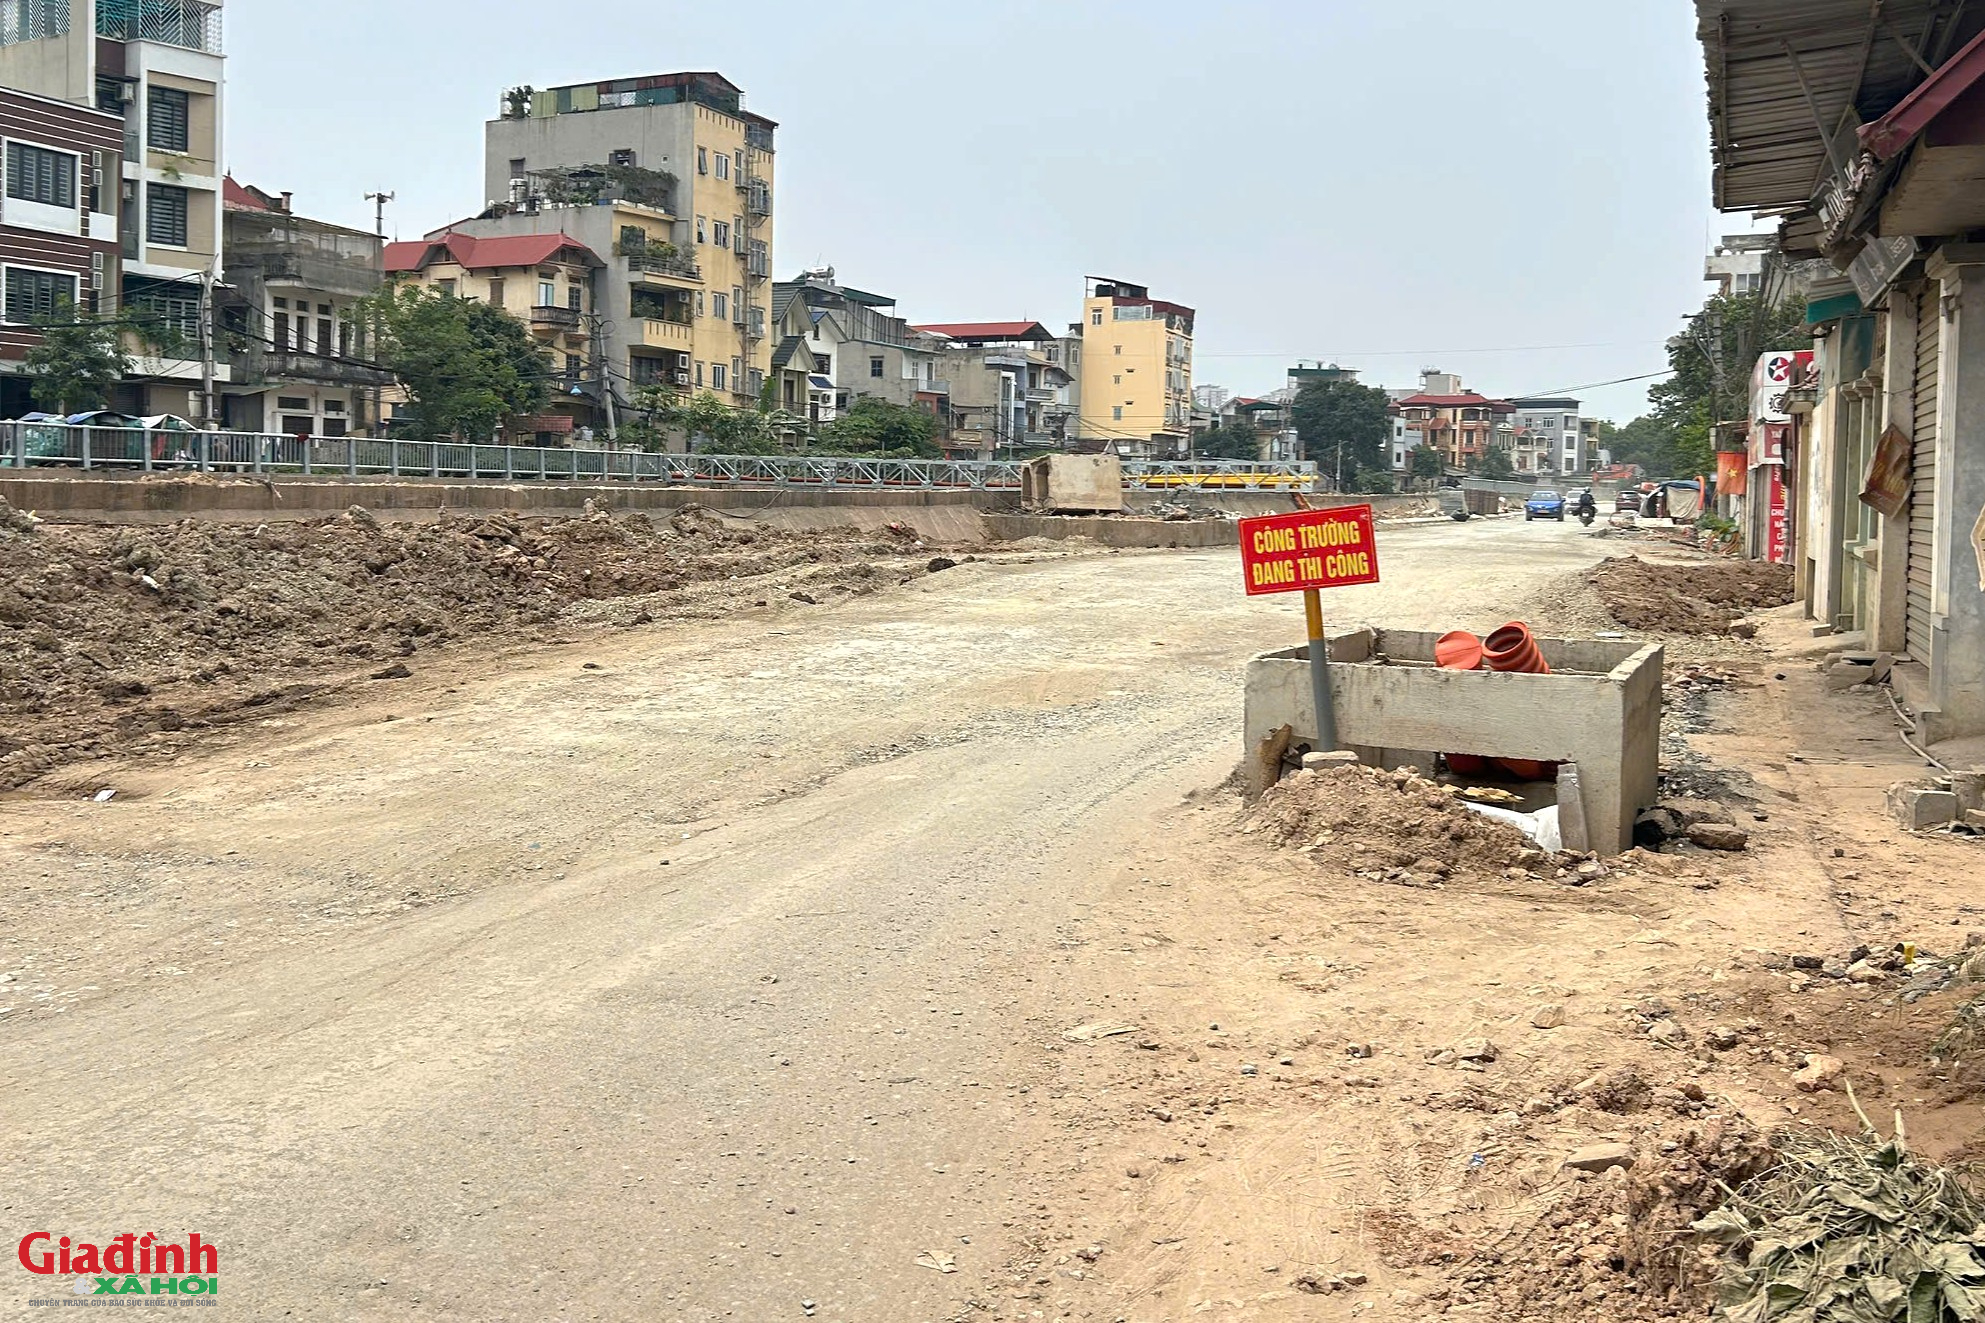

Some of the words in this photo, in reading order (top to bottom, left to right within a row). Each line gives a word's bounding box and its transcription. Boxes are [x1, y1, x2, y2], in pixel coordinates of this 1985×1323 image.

[1253, 526, 1296, 554] CÔNG
[1298, 518, 1361, 549] TRƯỜNG
[1252, 559, 1296, 586] ĐANG
[1297, 556, 1323, 581] THI
[1326, 550, 1369, 579] CÔNG
